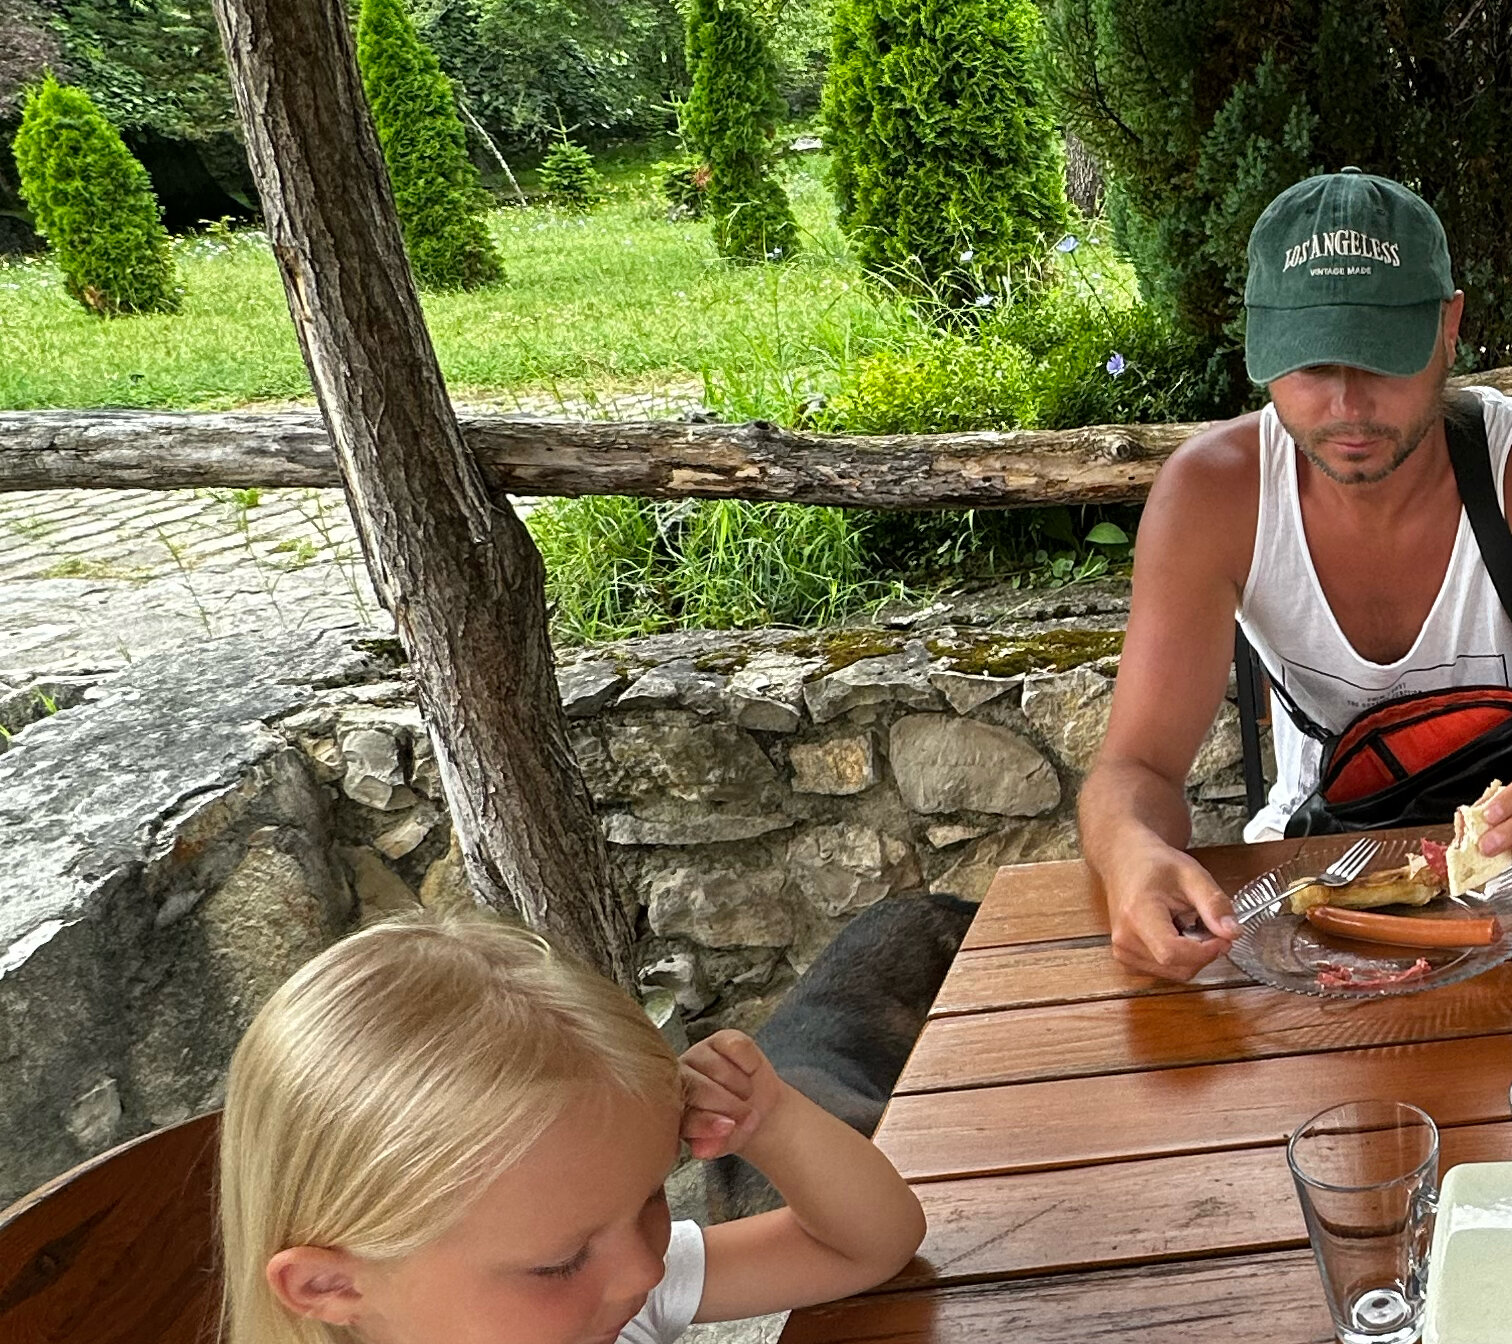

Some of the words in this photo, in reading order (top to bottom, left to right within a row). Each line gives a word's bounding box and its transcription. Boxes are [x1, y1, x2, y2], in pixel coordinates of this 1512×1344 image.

[1283, 240, 1310, 272] LOS
[1309, 230, 1400, 267] ANGELESS
[1310, 267, 1345, 277] VINTAGE
[1347, 266, 1372, 276] MADE
